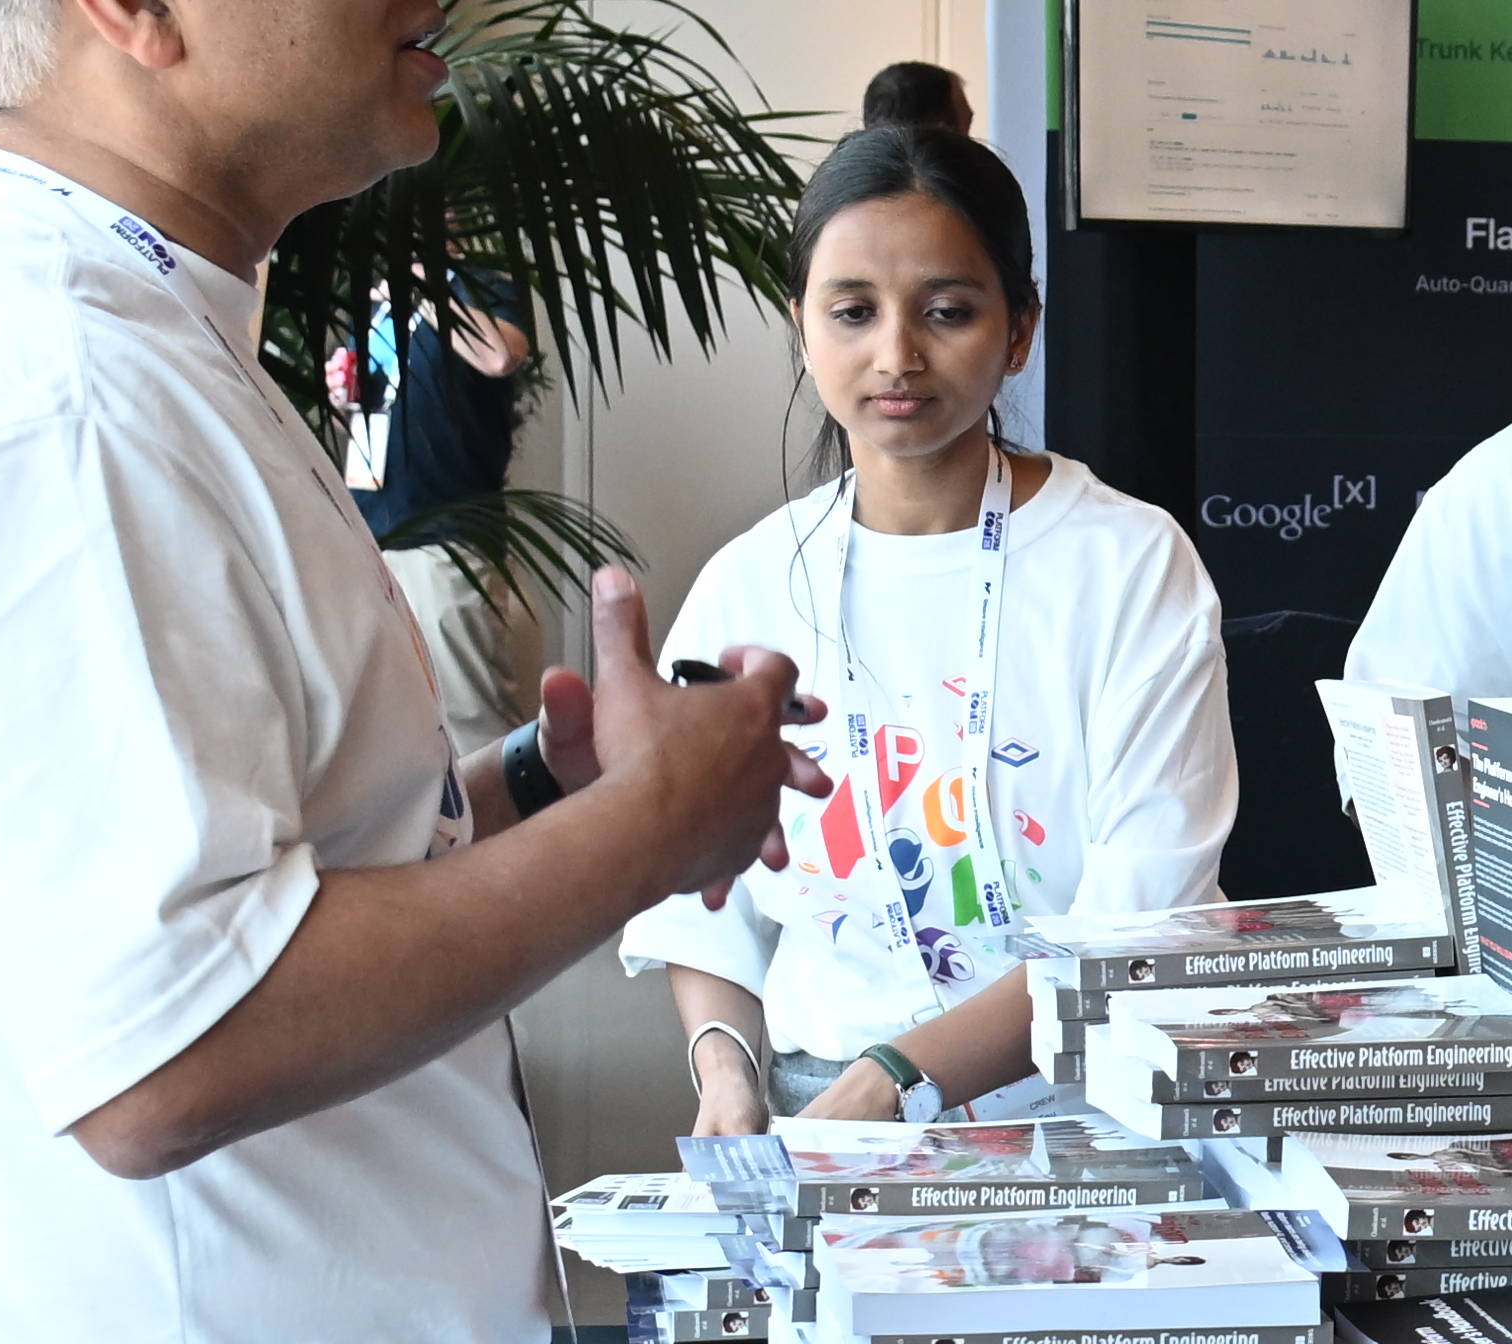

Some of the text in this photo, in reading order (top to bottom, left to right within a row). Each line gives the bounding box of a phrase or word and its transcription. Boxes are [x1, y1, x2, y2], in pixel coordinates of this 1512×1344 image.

[1417, 37, 1482, 61] Trunk
[110, 222, 169, 275] PLATFORM
[1445, 800, 1467, 862] Effective
[1185, 942, 1393, 975] Effective Platform Engineering
[1290, 1043, 1512, 1069] Effective Platform Engineering
[1030, 1094, 1055, 1110] CREW
[1273, 1102, 1490, 1127] Effective Platform Engineering
[912, 1185, 1137, 1208] Effective Platform Engineering
